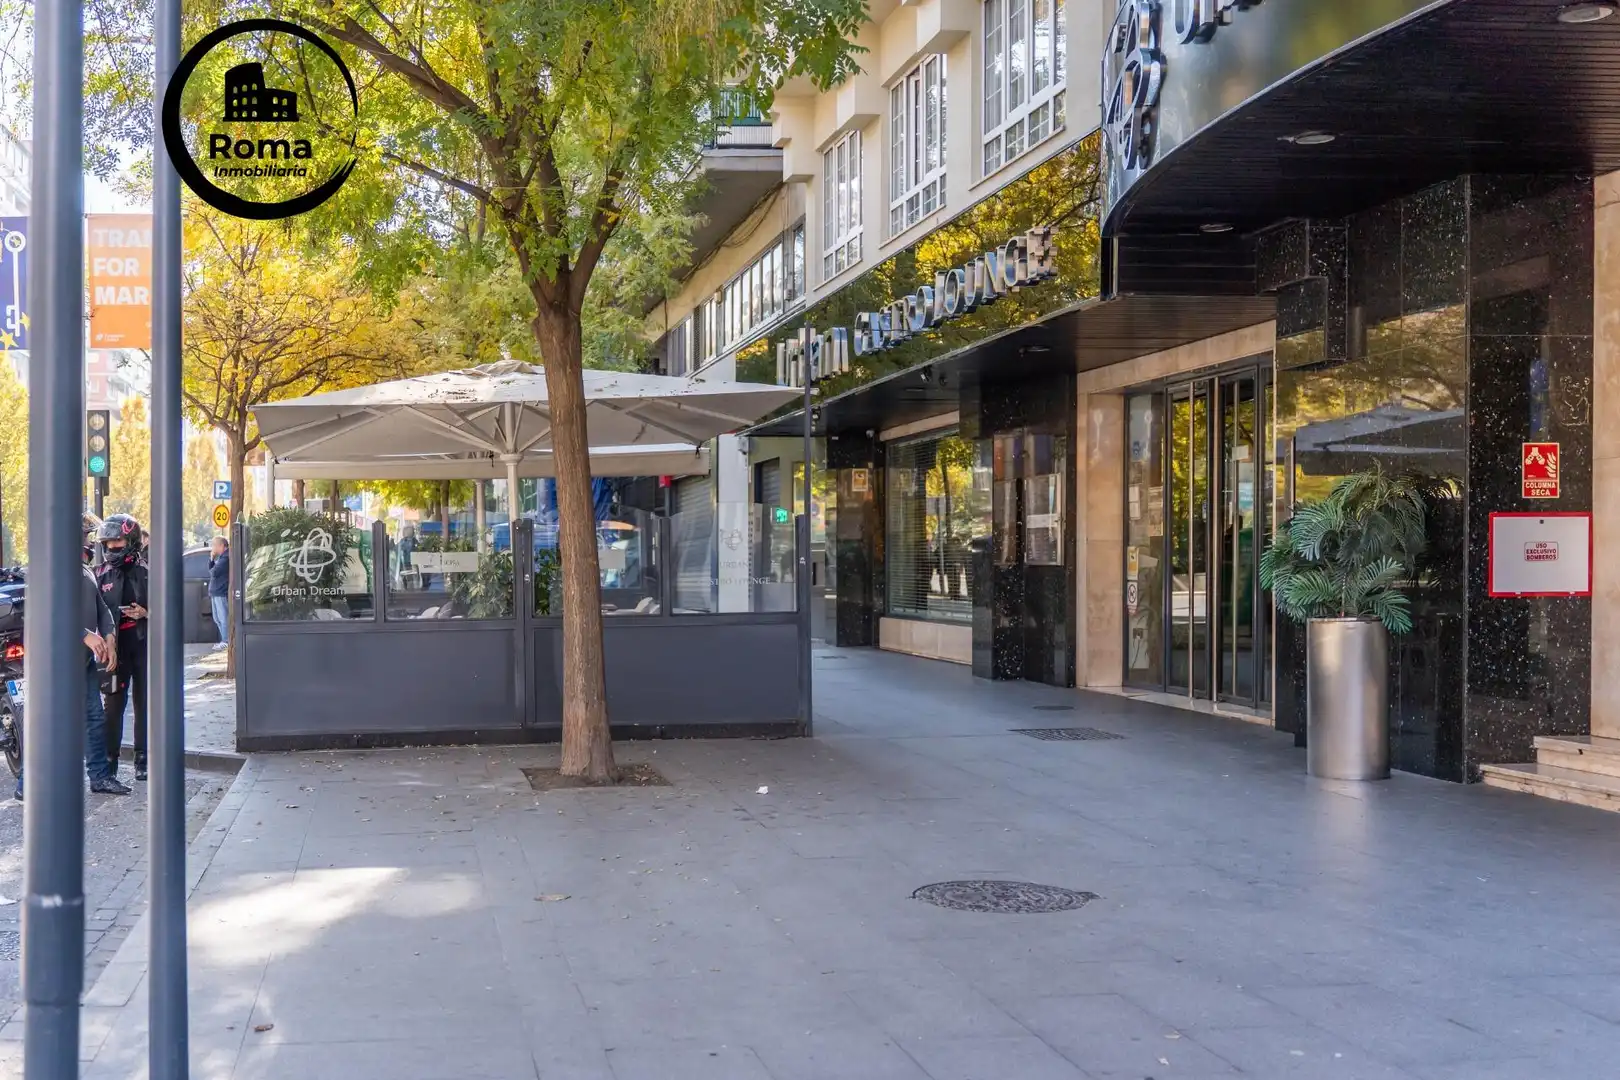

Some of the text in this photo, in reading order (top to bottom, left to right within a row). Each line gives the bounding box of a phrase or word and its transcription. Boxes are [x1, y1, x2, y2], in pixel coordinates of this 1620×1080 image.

[93, 257, 139, 276] FOR
[216, 512, 227, 520] 20
[272, 585, 347, 596] Urban Dream
